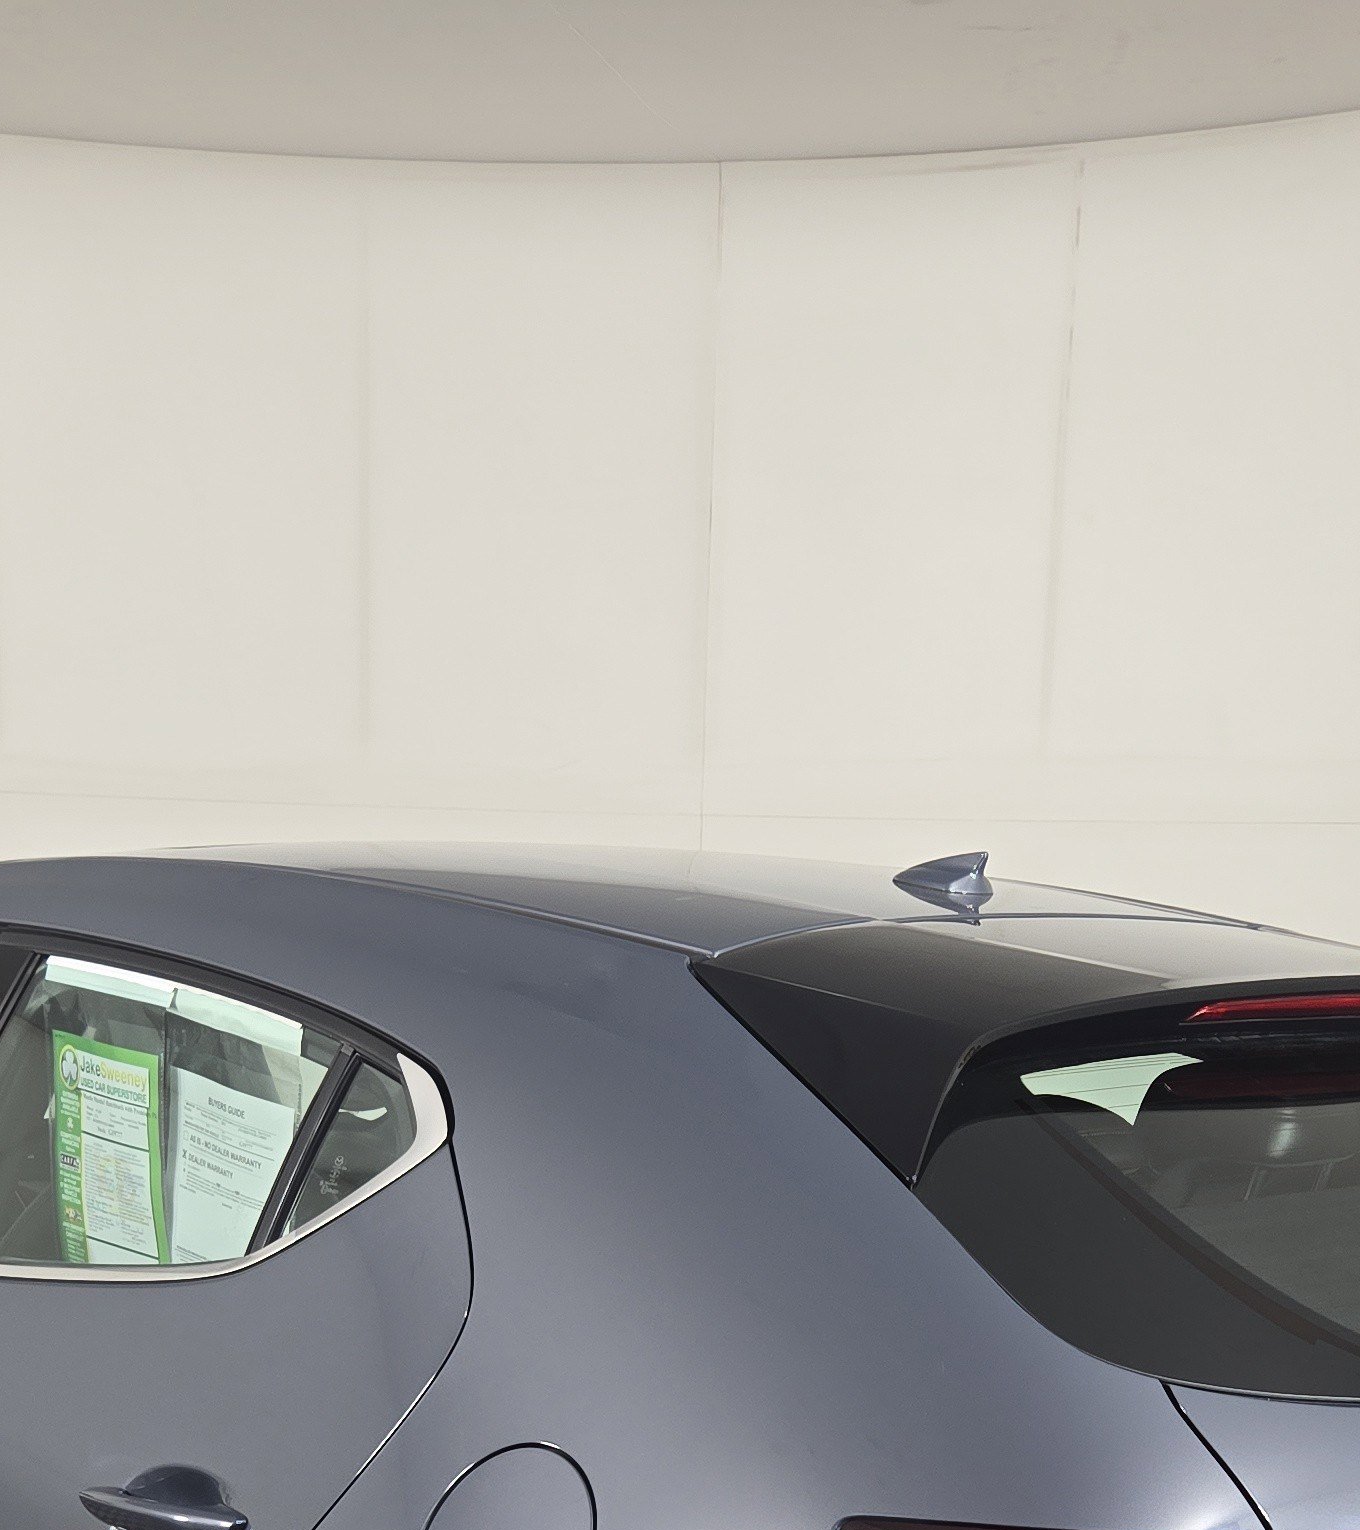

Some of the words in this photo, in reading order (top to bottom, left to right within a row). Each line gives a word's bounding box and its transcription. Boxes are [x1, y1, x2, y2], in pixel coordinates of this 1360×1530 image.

[80, 1055, 147, 1091] JakeSweeney
[107, 1085, 147, 1104] SUPERSTORE
[208, 1097, 227, 1113] BUYERS
[227, 1105, 246, 1120] GUIDE
[188, 1153, 207, 1167] DEALER
[207, 1162, 234, 1179] WARRANTY
[211, 1142, 230, 1158] DEALER
[230, 1150, 262, 1169] WARRANTY
